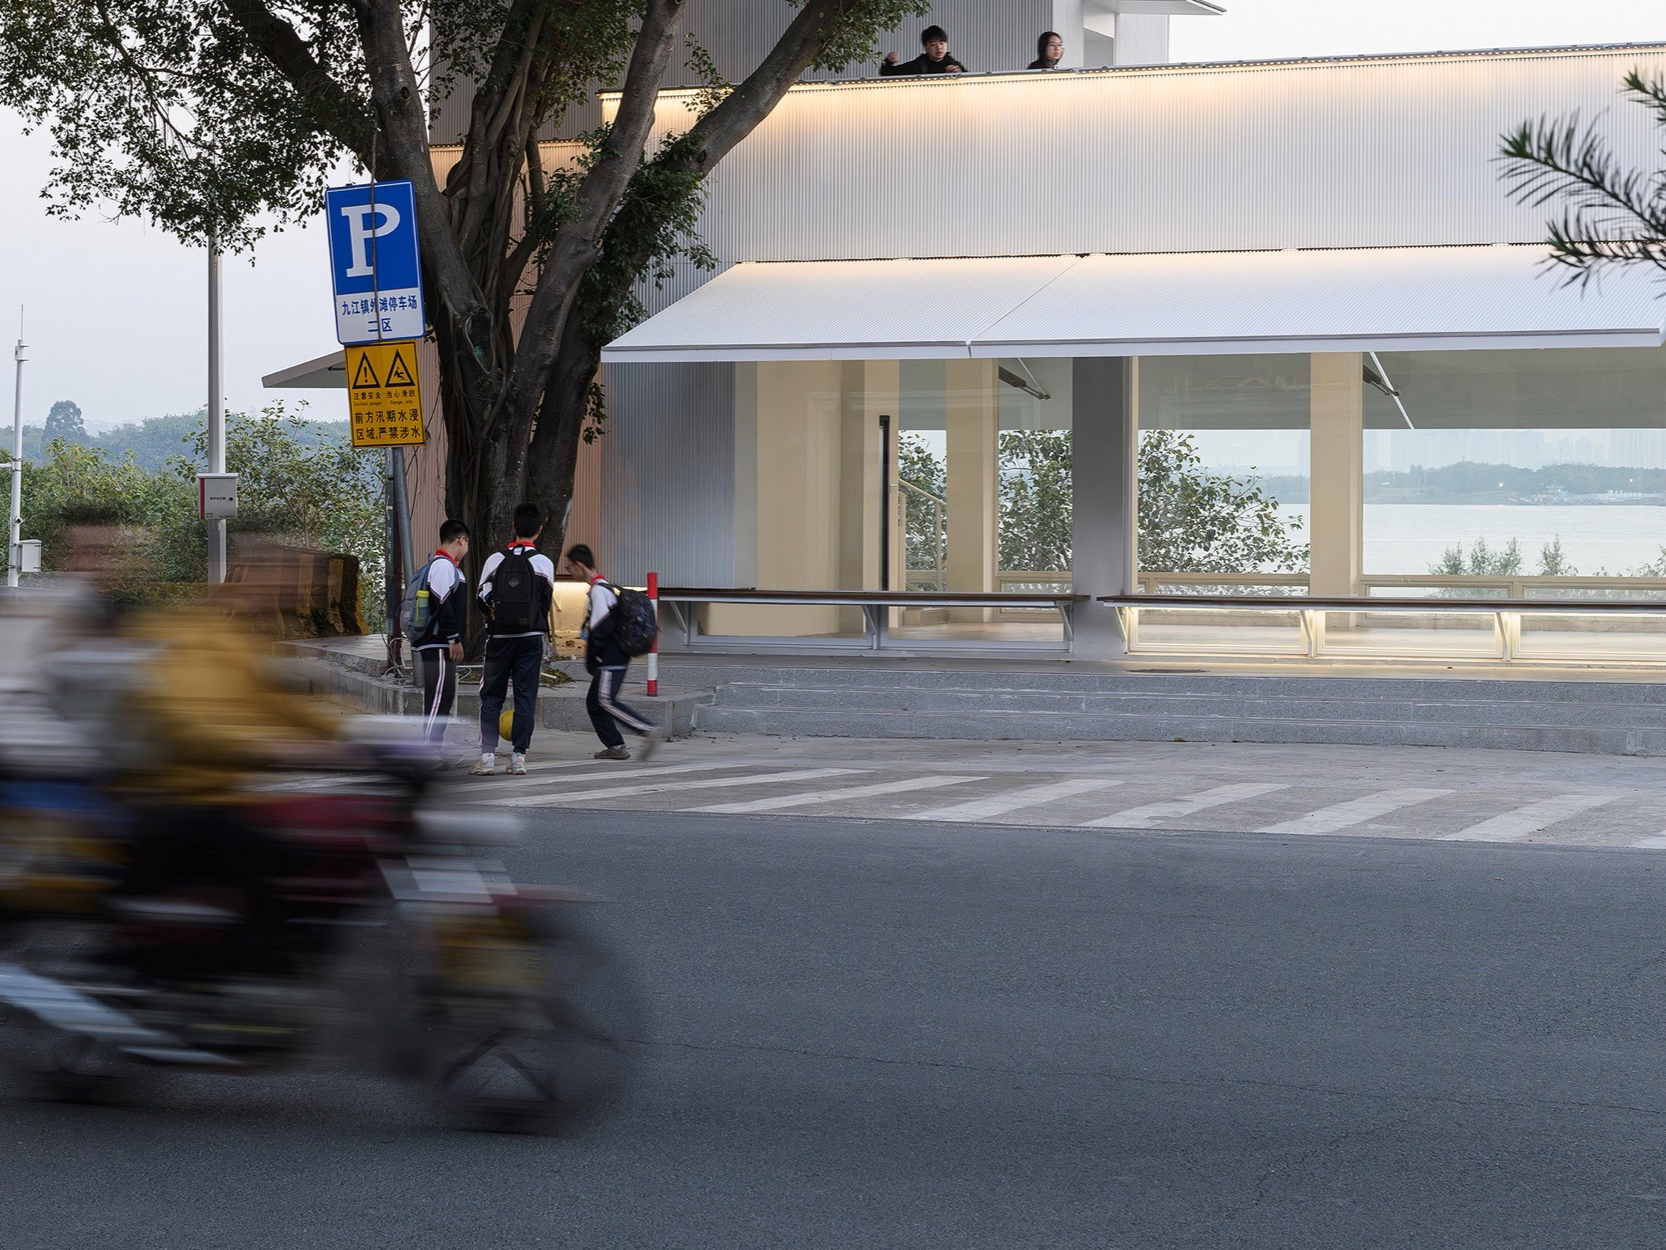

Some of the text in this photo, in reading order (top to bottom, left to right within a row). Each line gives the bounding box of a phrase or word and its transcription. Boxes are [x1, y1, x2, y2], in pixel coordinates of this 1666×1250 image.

[340, 203, 400, 278] P
[342, 294, 418, 316] 九江镇外滩停车场
[368, 317, 393, 332] 二区
[353, 391, 381, 400] 注意安全
[354, 408, 419, 424] 前方汛期水浸
